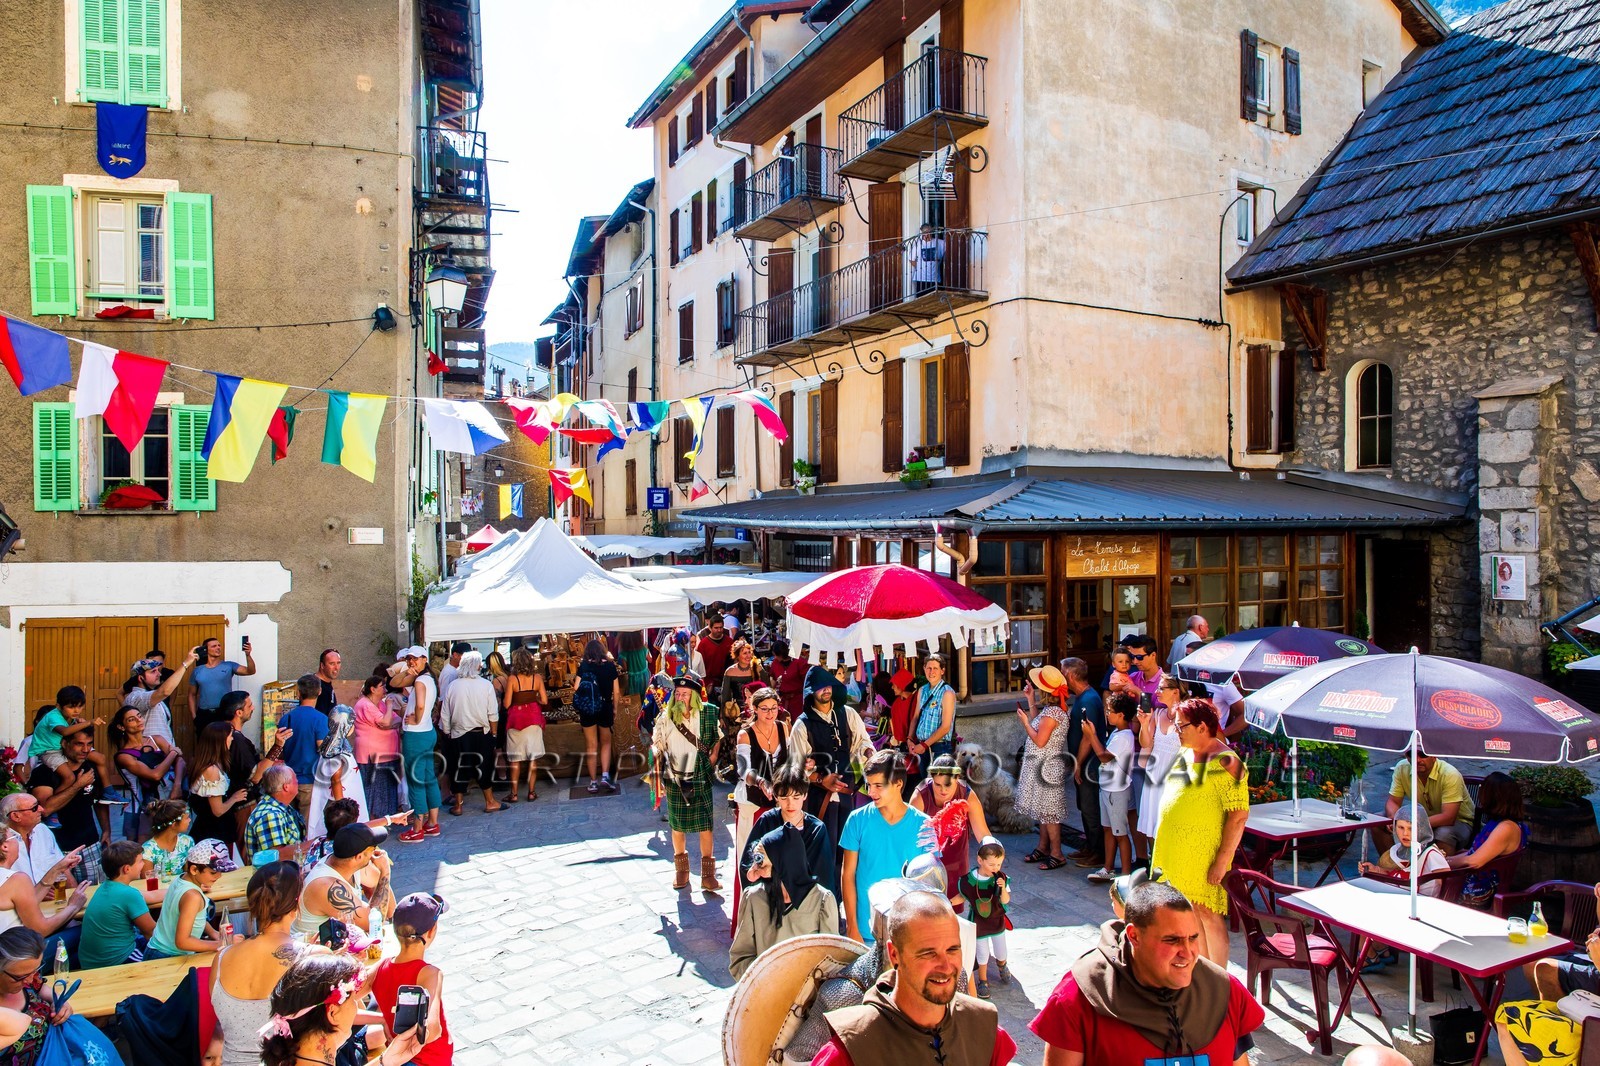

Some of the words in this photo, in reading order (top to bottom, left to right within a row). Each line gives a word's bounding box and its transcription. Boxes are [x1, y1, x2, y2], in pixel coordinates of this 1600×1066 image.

[1071, 537, 1084, 557] La
[1131, 541, 1141, 554] du
[1082, 558, 1110, 574] Chalet
[1112, 557, 1140, 574] d'Alpage
[399, 620, 406, 630] 6
[1263, 653, 1320, 667] DESPERADOS
[1320, 692, 1397, 713] DESPERADOS
[1438, 699, 1495, 719] DESPERADOS
